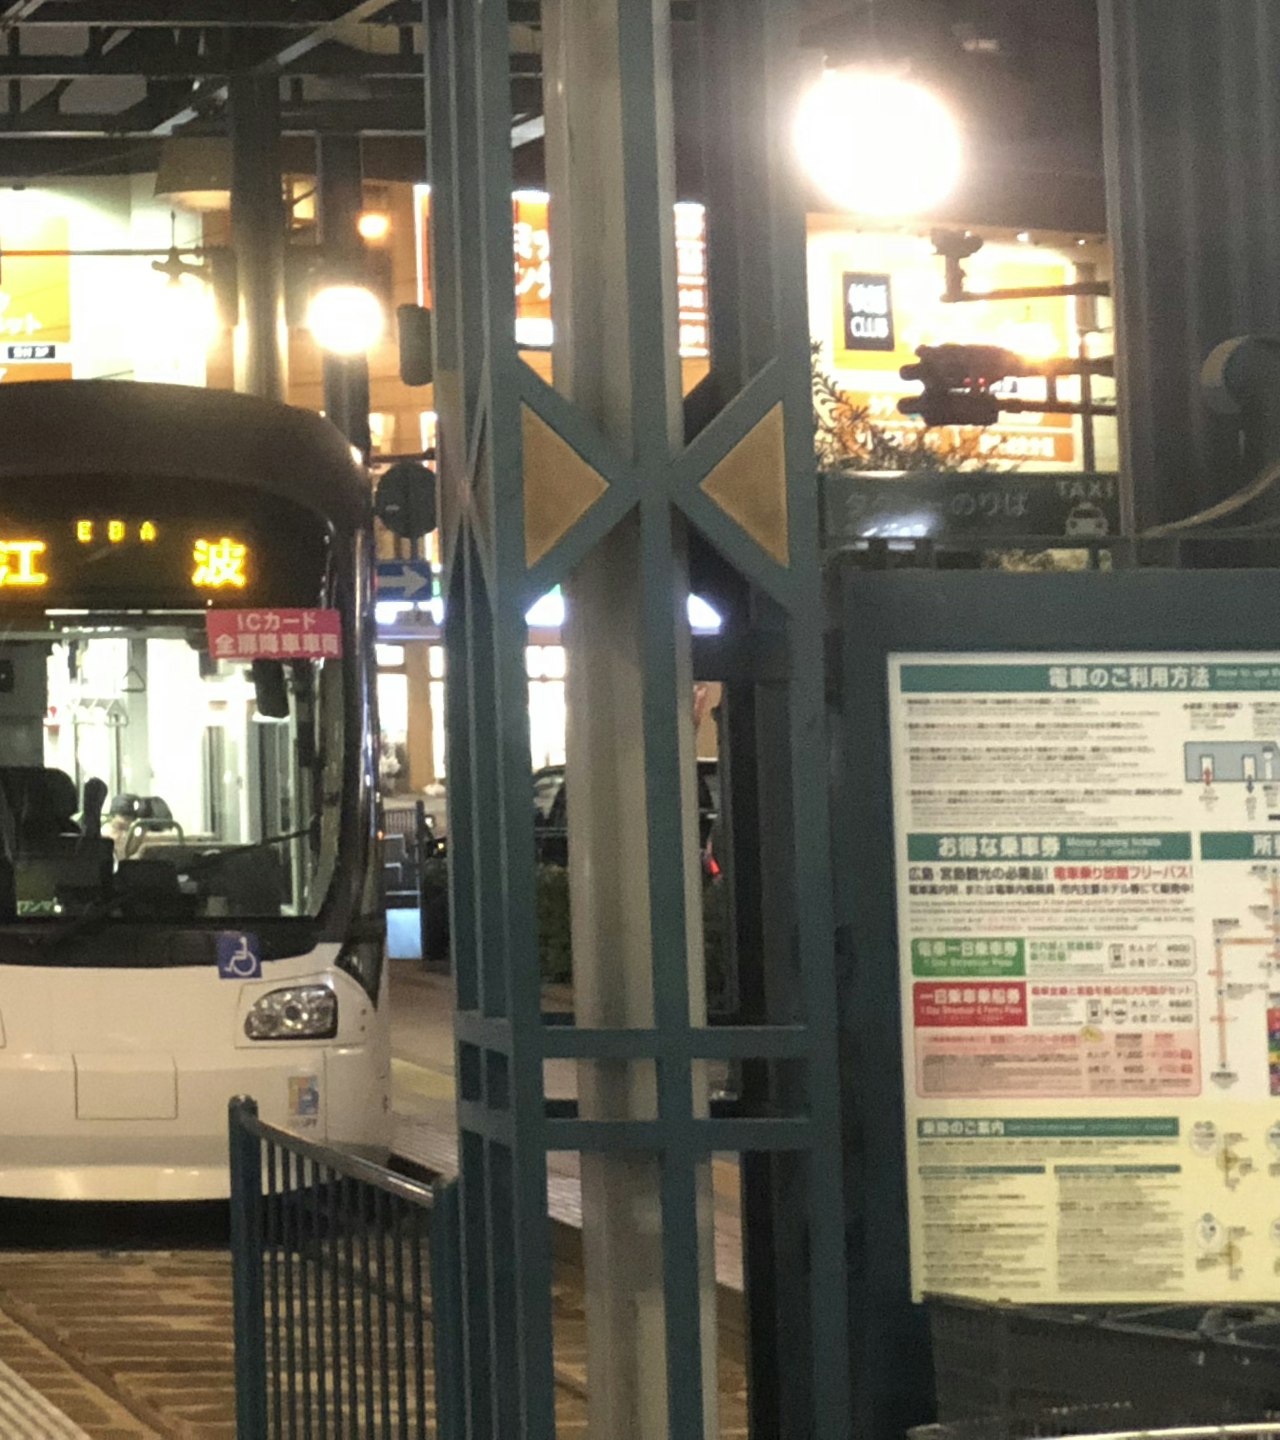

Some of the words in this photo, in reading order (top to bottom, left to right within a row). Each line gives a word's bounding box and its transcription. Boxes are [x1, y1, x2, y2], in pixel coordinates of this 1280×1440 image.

[76, 520, 157, 544] EBA
[236, 611, 317, 631] ICカード
